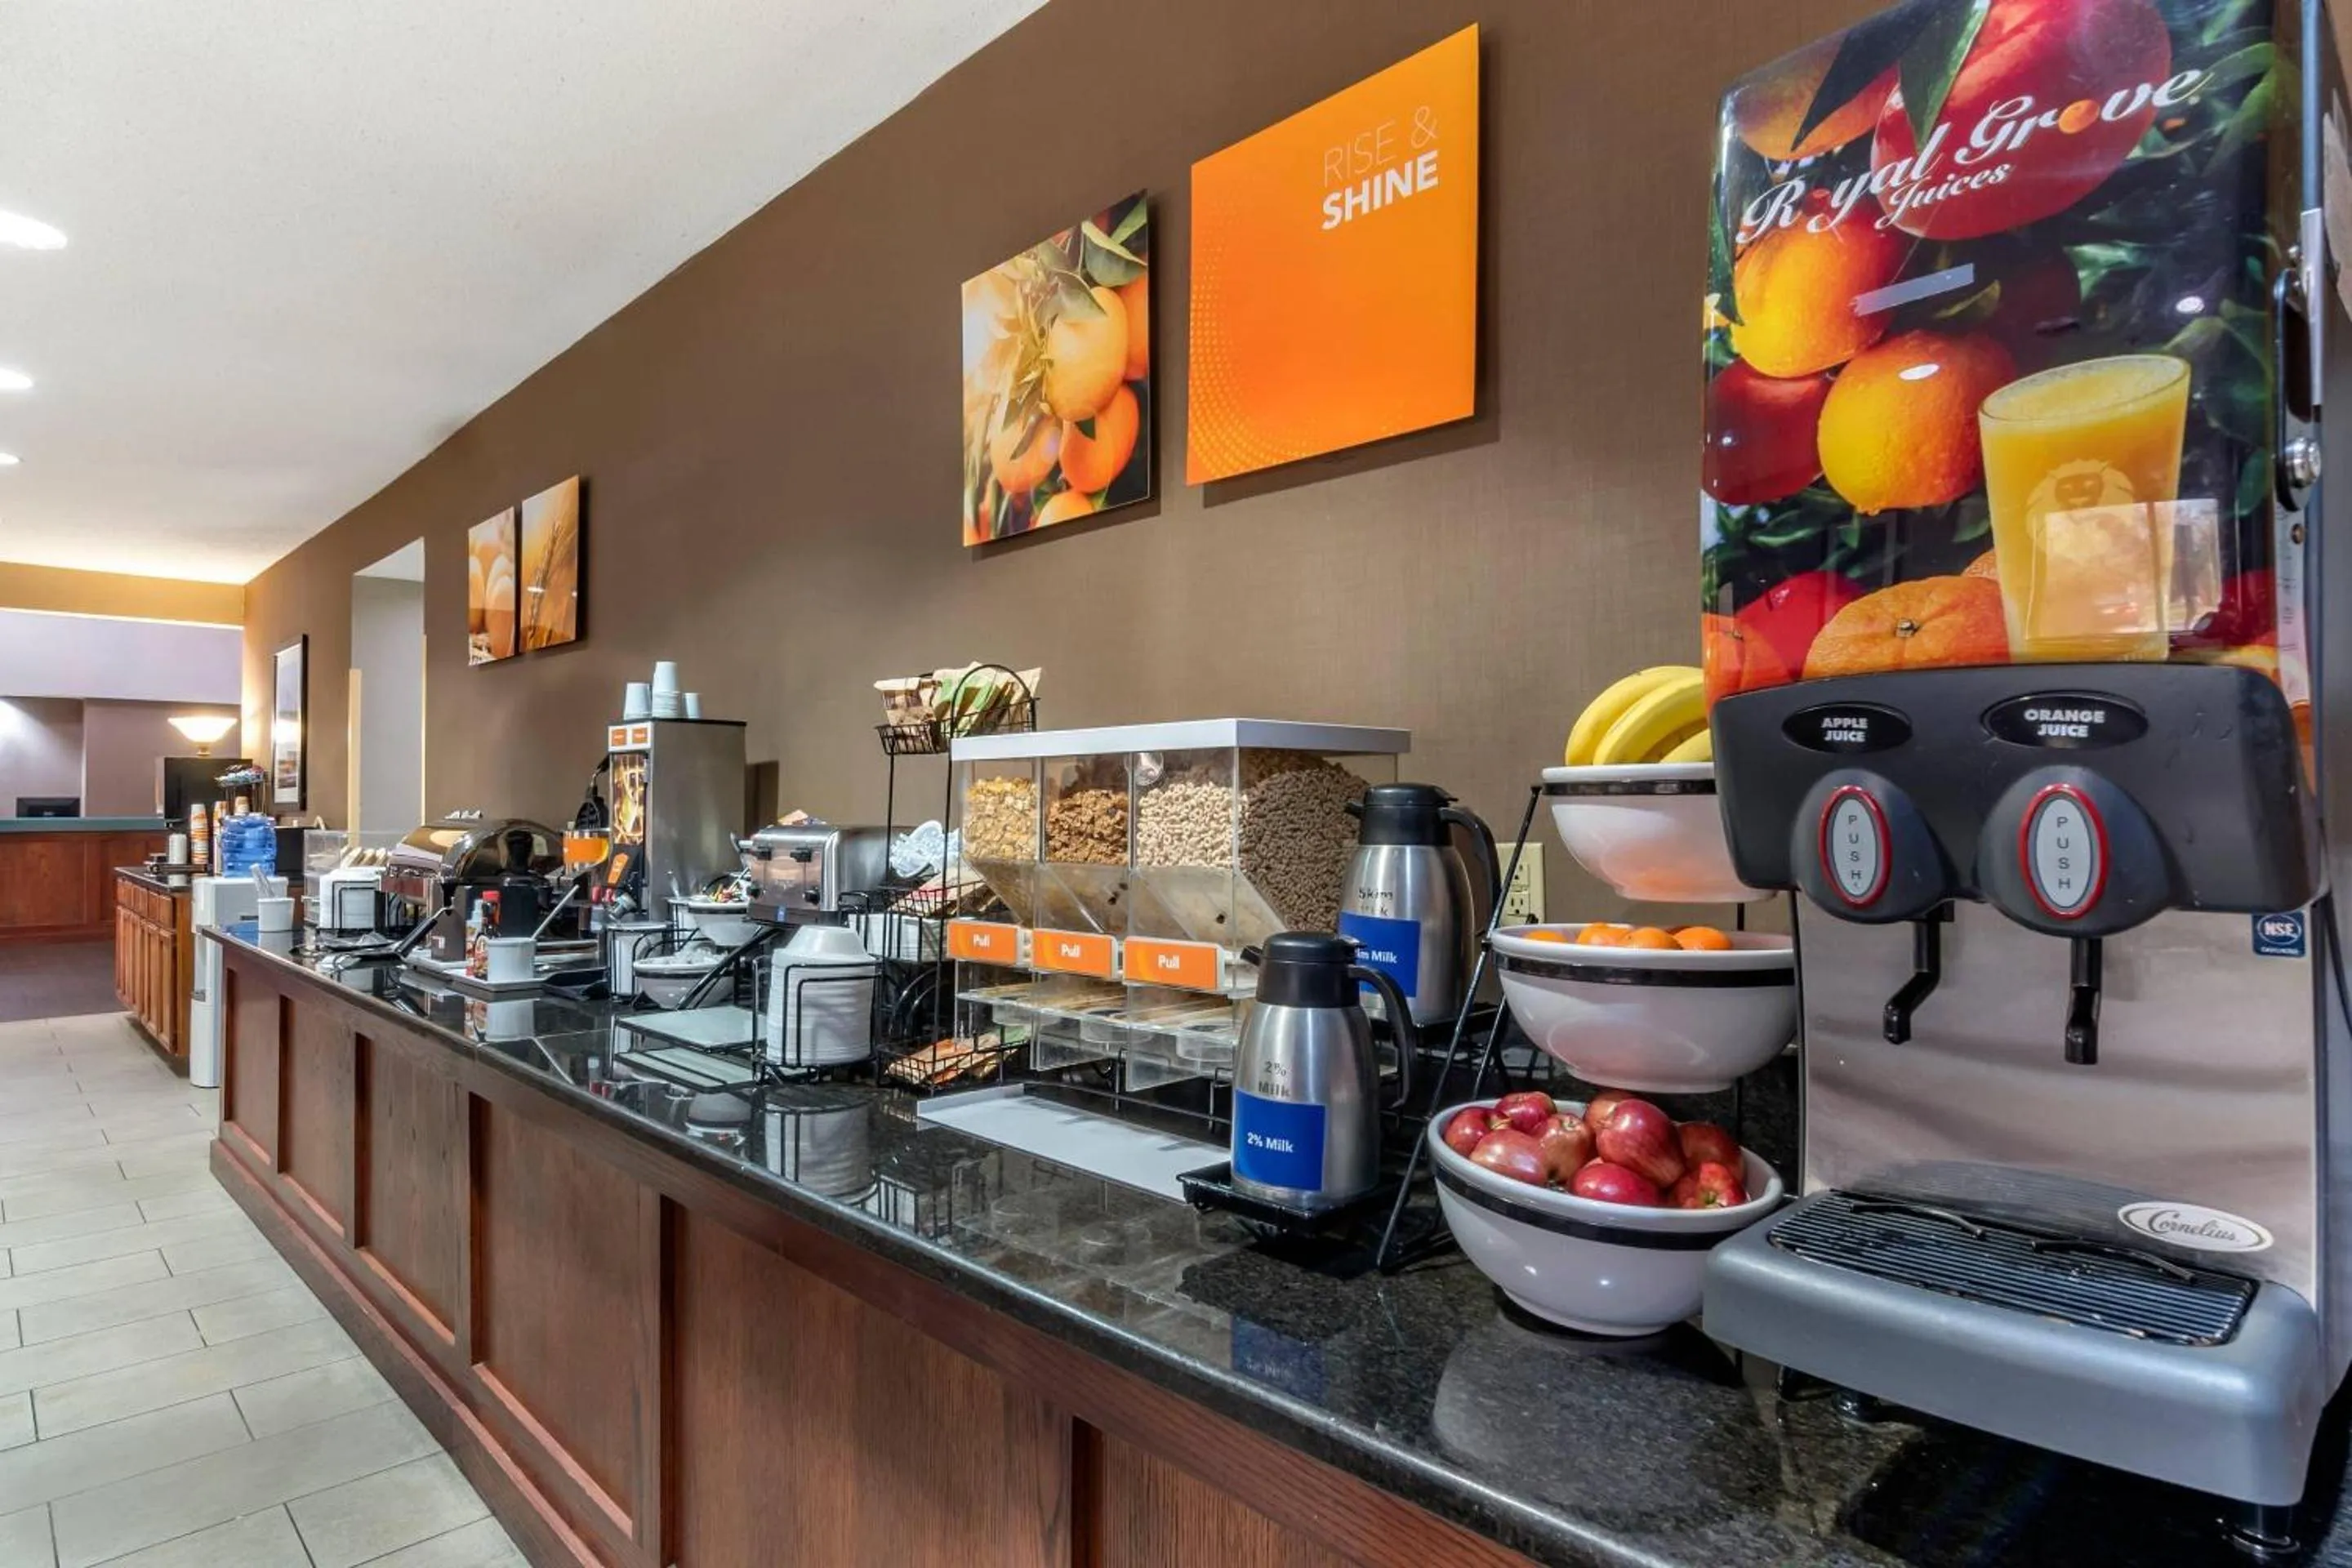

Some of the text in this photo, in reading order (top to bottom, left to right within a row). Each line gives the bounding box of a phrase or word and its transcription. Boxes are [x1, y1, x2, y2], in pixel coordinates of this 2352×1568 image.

[1953, 69, 2214, 164] Grove
[1324, 105, 1437, 188] RISE &
[1321, 149, 1438, 230] SHINE
[1873, 163, 2011, 229] Juices
[1821, 717, 1868, 728] APPLE
[2024, 708, 2105, 724] ORANGE
[1824, 730, 1865, 742] JUICE
[2037, 724, 2088, 737] JUICE
[1848, 815, 1862, 880] PUSH
[2056, 817, 2071, 889] PUSH
[973, 933, 990, 948] Pull
[1061, 943, 1080, 958] Pull
[1371, 951, 1397, 964] Milk
[1158, 954, 1179, 969] Pull
[1247, 1132, 1294, 1153] 2% Milk
[2148, 1209, 2236, 1241] Cornelius
